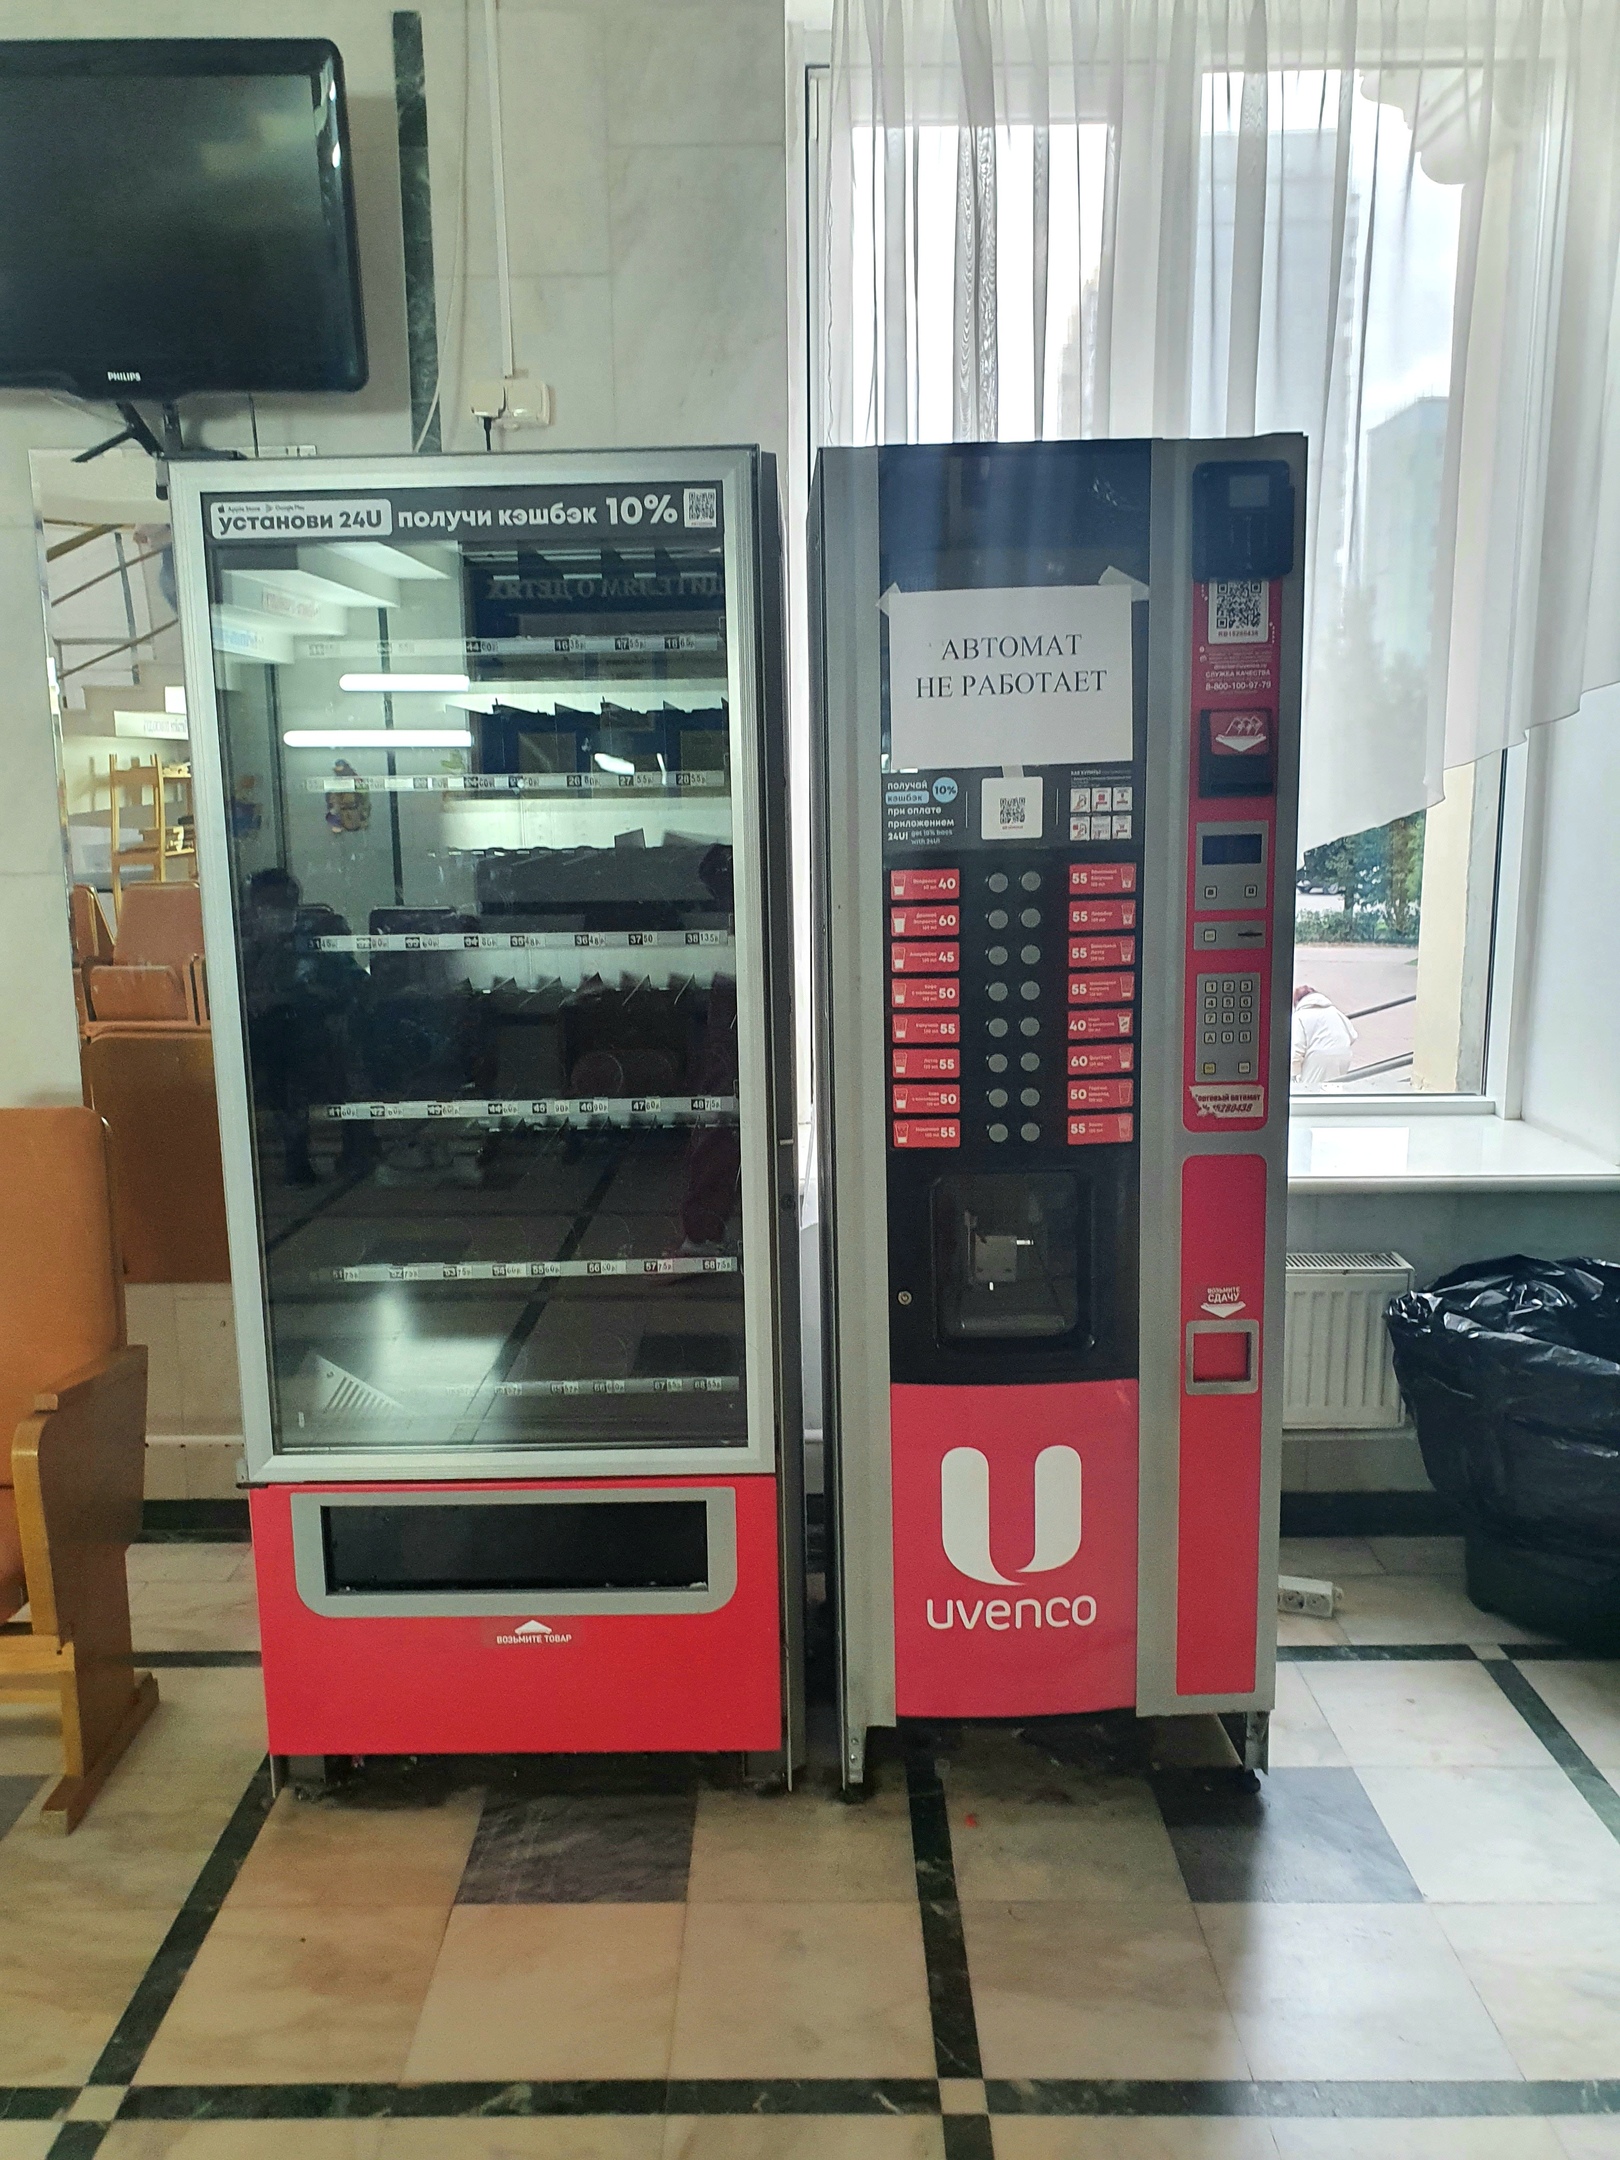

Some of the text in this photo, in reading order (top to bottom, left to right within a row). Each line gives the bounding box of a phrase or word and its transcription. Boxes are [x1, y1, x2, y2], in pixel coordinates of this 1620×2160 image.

[107, 371, 141, 381] PHILIPS
[398, 494, 678, 533] получи кэшбэк 10%
[218, 510, 382, 535] установи 24U
[615, 638, 629, 650] 17
[941, 633, 1082, 662] АВТОМАТ
[1205, 670, 1271, 679] СЛУЖБА КАЧЕСТВА
[916, 669, 1107, 699] НЕ РАБОТАЕТ
[619, 775, 634, 787] 27
[887, 780, 957, 796] получай 10%
[887, 793, 923, 802] кэшбэк
[887, 806, 942, 818] при оплате
[887, 819, 955, 830] приложением
[938, 877, 957, 890] 40
[1072, 872, 1088, 885] 55
[938, 914, 957, 927] 60
[1072, 910, 1088, 923] 55
[575, 935, 589, 946] 36
[629, 934, 643, 945] 37
[685, 933, 699, 944] 38
[938, 951, 955, 963] 45
[1071, 947, 1088, 959] 55
[938, 987, 957, 1000] 50
[1071, 983, 1088, 996] 55
[939, 1023, 956, 1035] 55
[1069, 1019, 1088, 1032] 40
[939, 1058, 955, 1070] 55
[1071, 1055, 1088, 1067] 60
[940, 1093, 957, 1105] 50
[1070, 1089, 1088, 1100] 50
[488, 1103, 503, 1114] 44
[532, 1102, 547, 1113] 45
[579, 1102, 593, 1112] 46
[632, 1101, 645, 1112] 47
[691, 1099, 705, 1110] 48
[328, 1106, 341, 1117] 41
[940, 1126, 956, 1138] 55
[1070, 1123, 1086, 1135] 55
[644, 1261, 658, 1272] 57
[702, 1259, 717, 1270] 58
[1207, 1286, 1240, 1294] ВОЗЬМИТЕ
[1208, 1293, 1239, 1303] СДАЧУ
[926, 1595, 1097, 1631] uvenco
[496, 1634, 573, 1645] ВОЗЬМИТЕ ТОВАР
